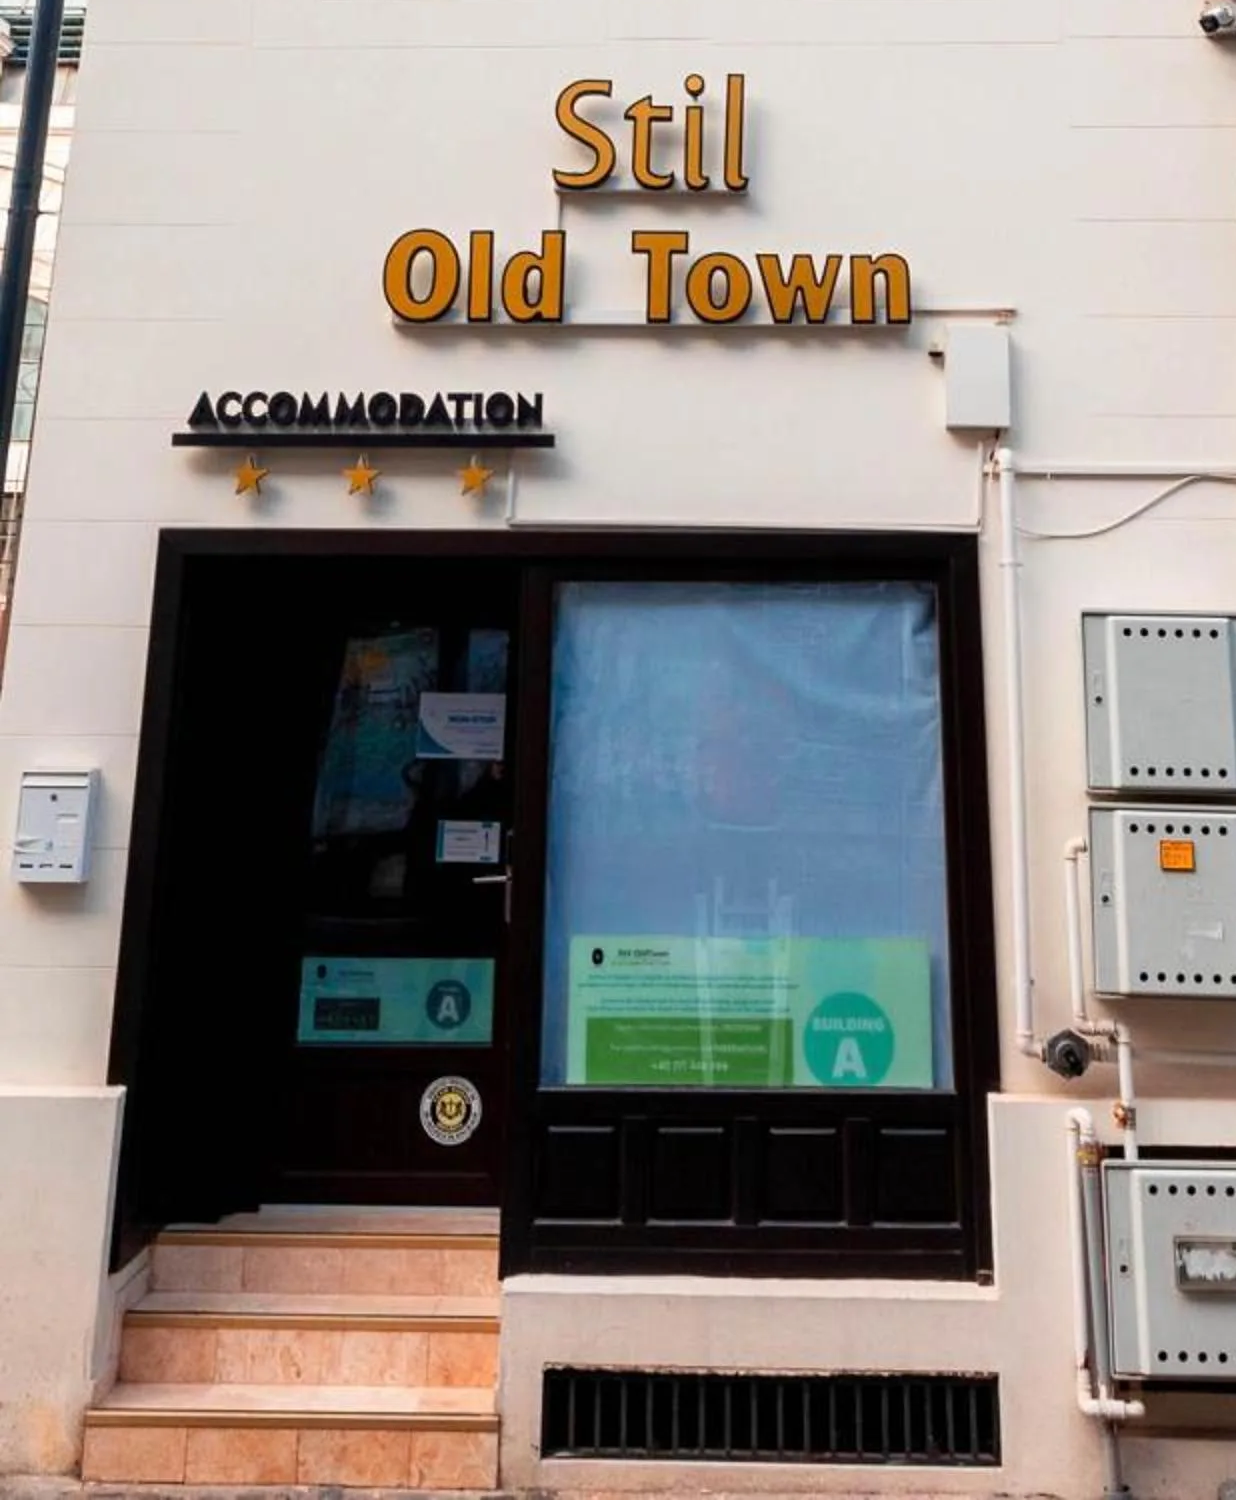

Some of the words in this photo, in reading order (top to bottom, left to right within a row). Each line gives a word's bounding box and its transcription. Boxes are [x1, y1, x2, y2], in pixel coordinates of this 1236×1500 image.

[552, 73, 750, 190] Stil
[383, 229, 566, 322] Old
[632, 230, 912, 324] Town
[187, 391, 544, 430] ACCOMMODATION
[436, 995, 460, 1023] A
[813, 1016, 885, 1033] BUILDING
[832, 1038, 868, 1079] A
